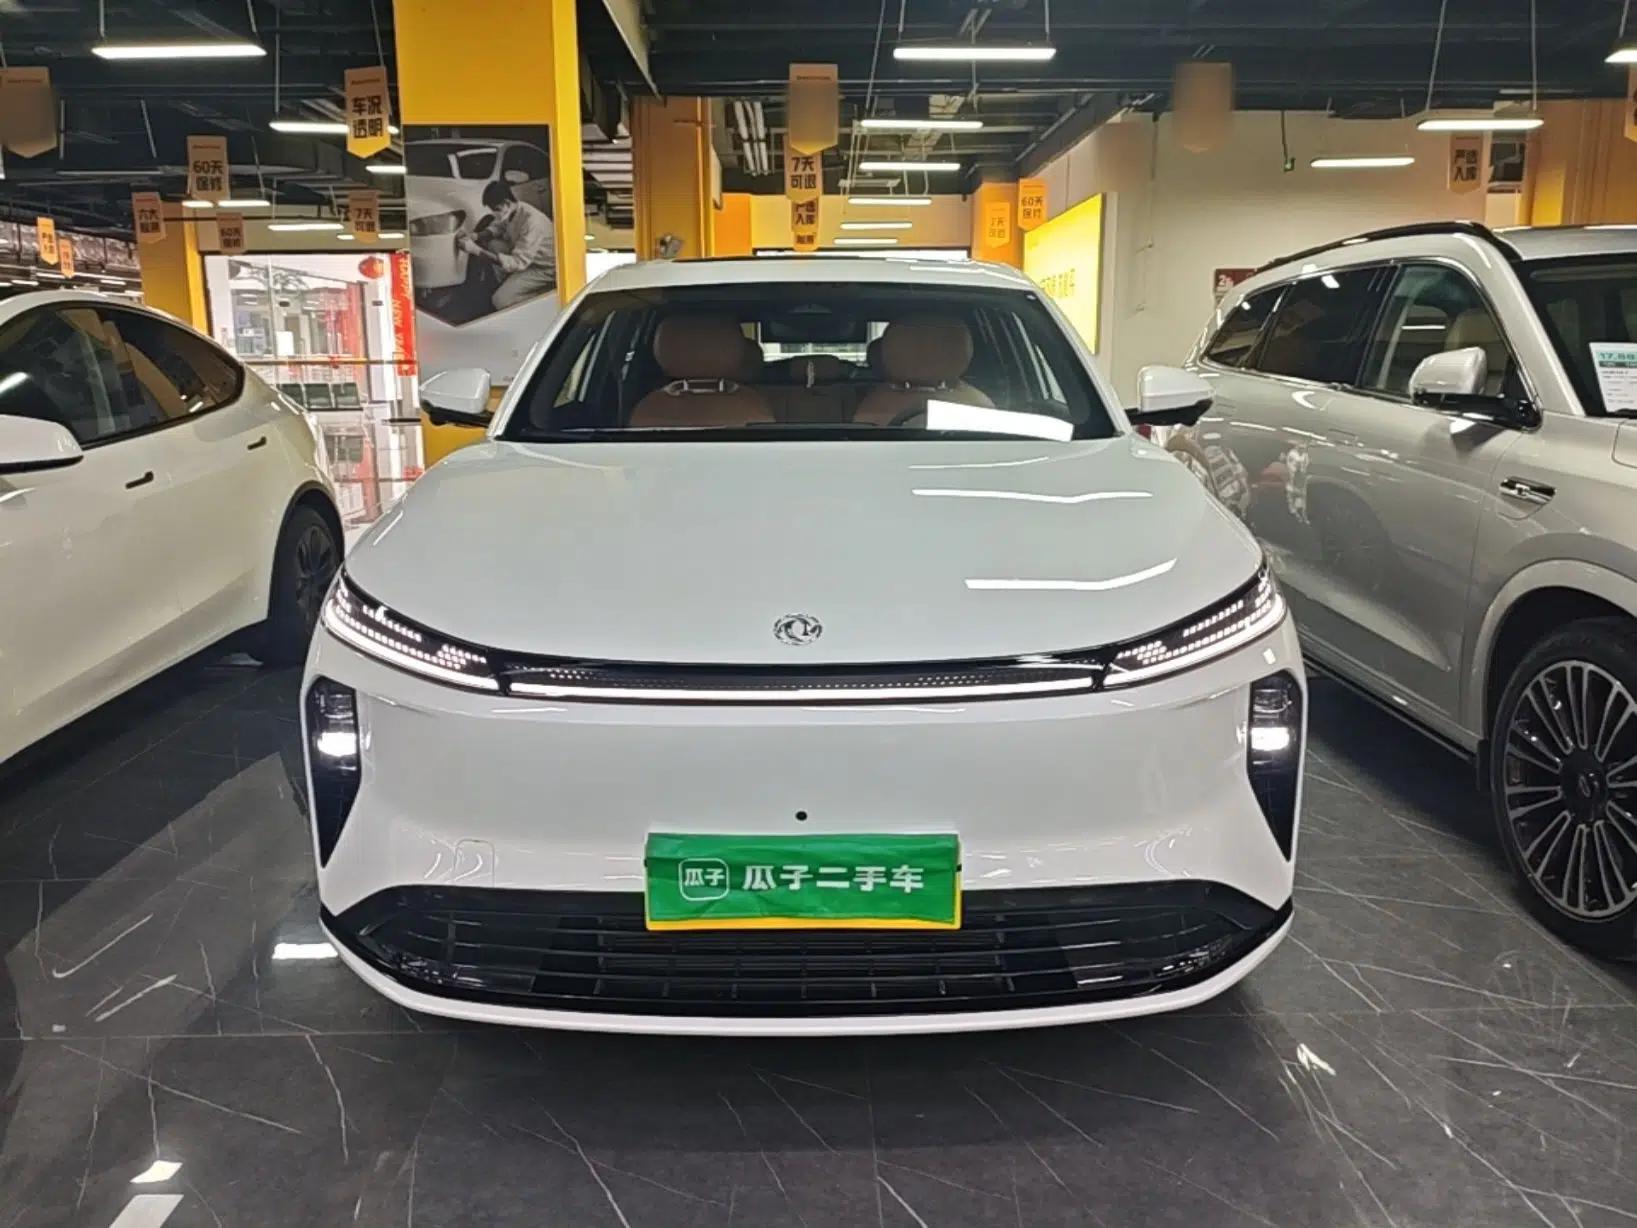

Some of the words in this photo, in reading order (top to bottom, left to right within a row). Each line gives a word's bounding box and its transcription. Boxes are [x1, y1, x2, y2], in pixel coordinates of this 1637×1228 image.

[351, 95, 382, 116] 车况
[352, 117, 384, 139] 透明
[193, 159, 223, 174] 60天
[792, 156, 815, 172] 7天
[684, 867, 725, 888] 瓜子
[742, 864, 926, 894] 瓜子二手车
